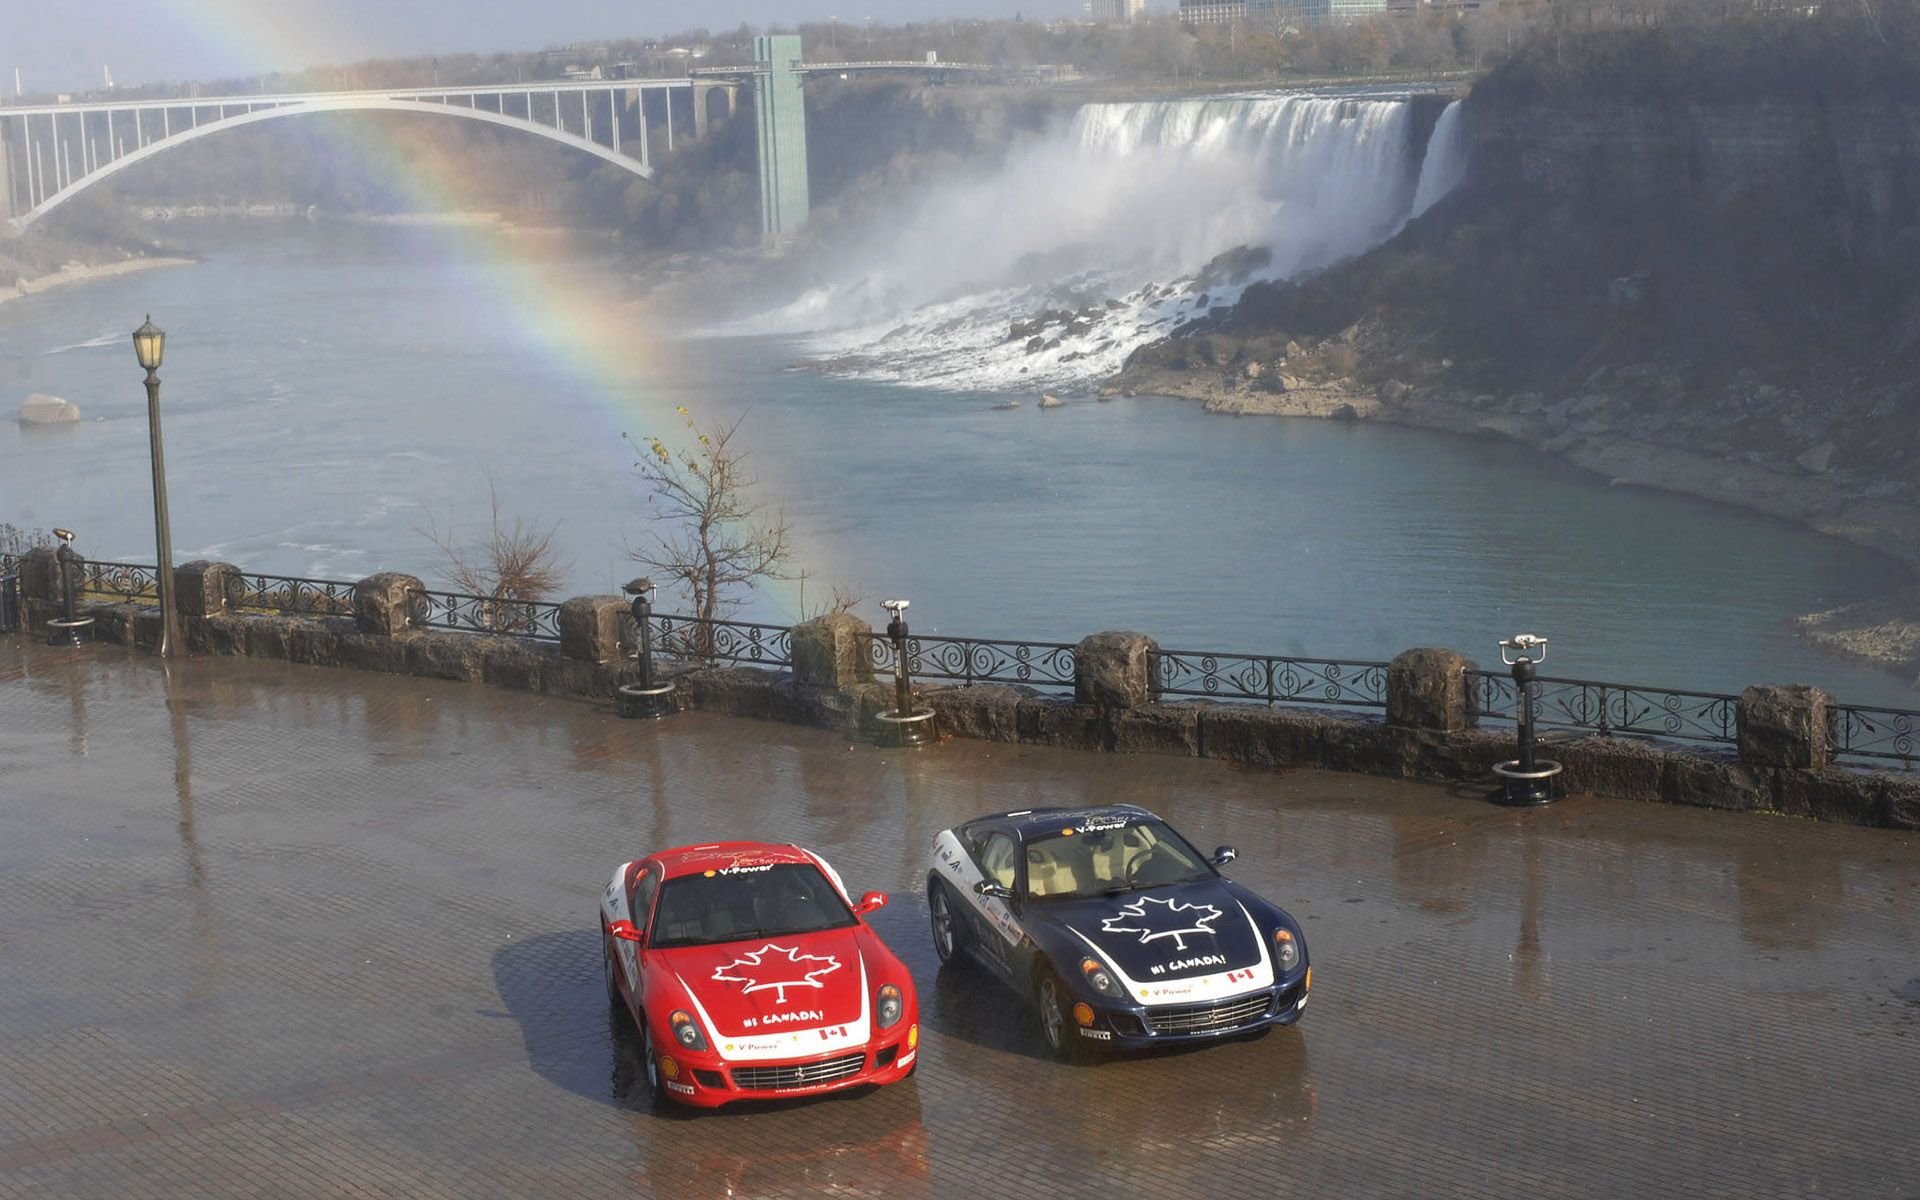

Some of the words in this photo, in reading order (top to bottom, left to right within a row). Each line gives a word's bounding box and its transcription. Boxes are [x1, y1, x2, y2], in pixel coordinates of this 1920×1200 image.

[1075, 820, 1127, 834] V-Power
[718, 863, 774, 876] V-Power
[1168, 954, 1227, 971] CANADA!
[761, 1009, 824, 1025] CANADA!
